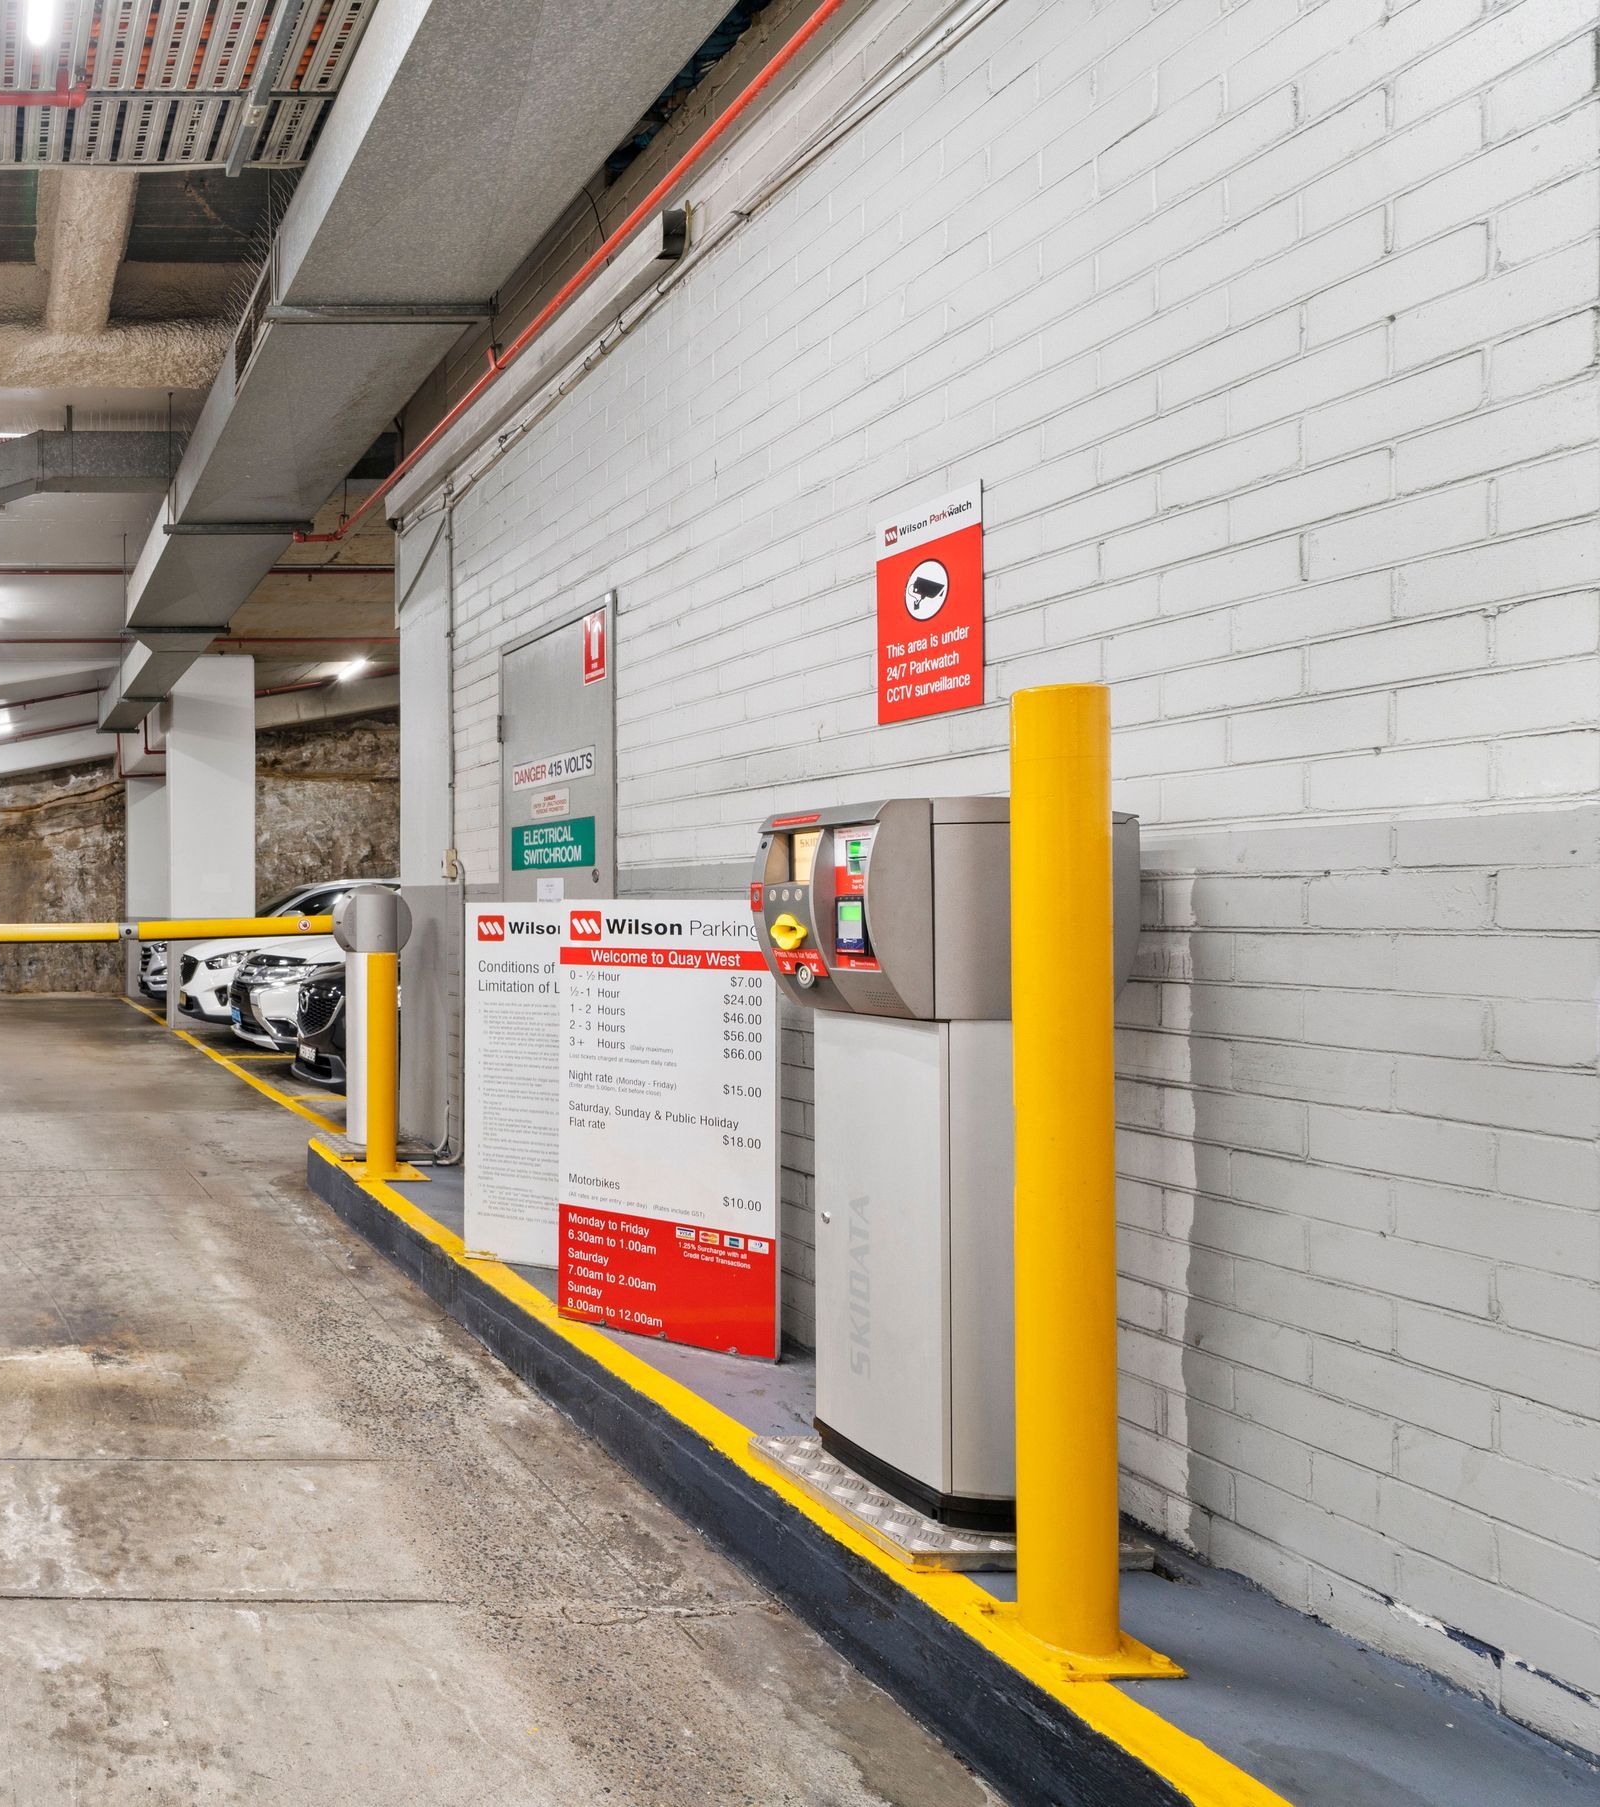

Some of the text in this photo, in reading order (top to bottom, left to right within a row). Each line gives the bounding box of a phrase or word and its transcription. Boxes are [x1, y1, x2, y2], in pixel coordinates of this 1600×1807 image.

[899, 501, 972, 537] Wilson Parkwatch
[887, 625, 970, 659] This area is under
[887, 651, 959, 681] 24/7 Parkwatch
[887, 673, 970, 703] CCTV surveillance
[514, 752, 592, 785] DANGER 415 VOLTS
[524, 826, 574, 846] ELECTRICAL
[524, 845, 581, 865] SWITCHROOM
[509, 922, 560, 934] Wilso
[606, 919, 683, 936] Wilson
[478, 960, 556, 974] Conditions of
[591, 950, 741, 968] Welcome to Quay West
[570, 970, 621, 982] 0 Hour
[730, 977, 762, 989] $7.00
[478, 979, 534, 993] Limitation
[539, 981, 550, 994] of
[598, 988, 620, 999] Hour
[723, 994, 762, 1007] $24.00
[570, 1004, 626, 1016] 1 2 Hours
[723, 1012, 762, 1025] $46.00
[569, 1020, 626, 1033] 2 3 Hours
[723, 1030, 762, 1043] $56.00
[597, 1038, 625, 1050] Hours
[630, 1044, 645, 1053] (Daily
[597, 1055, 617, 1063] charged
[624, 1057, 650, 1065] maximum
[651, 1059, 663, 1067] daily
[723, 1048, 762, 1061] $66.00
[569, 1070, 677, 1091] Night rate (Monday Friday)
[628, 1087, 645, 1095] before
[645, 1089, 661, 1097] close)
[723, 1084, 762, 1098] $15.00
[569, 1116, 606, 1130] Flat rate
[615, 1105, 651, 1120] Sunday
[654, 1110, 662, 1120] &
[666, 1111, 697, 1125] Public
[700, 1115, 739, 1131] Holiday
[722, 1135, 761, 1149] $18.00
[568, 1173, 621, 1190] Motorbikes
[609, 1197, 622, 1206] entry
[626, 1199, 634, 1207] per
[635, 1201, 648, 1209] day)
[652, 1204, 669, 1213] (Rates
[670, 1207, 690, 1217] include
[691, 1210, 705, 1219] GST)
[723, 1196, 761, 1212] $10.00
[568, 1212, 650, 1238] Monday to Friday
[568, 1229, 656, 1255] 6.30am to 1.00am
[679, 1242, 696, 1250] 1.25%
[697, 1245, 725, 1256] Surcharge
[568, 1247, 609, 1267] Saturday
[683, 1251, 751, 1269] Credit Card Transactions
[568, 1264, 656, 1292] 7.00am to 2.00am
[568, 1281, 602, 1299] Sunday
[849, 1194, 871, 1380] SKIDATA
[568, 1298, 663, 1327] 8.00am to 12.00am
